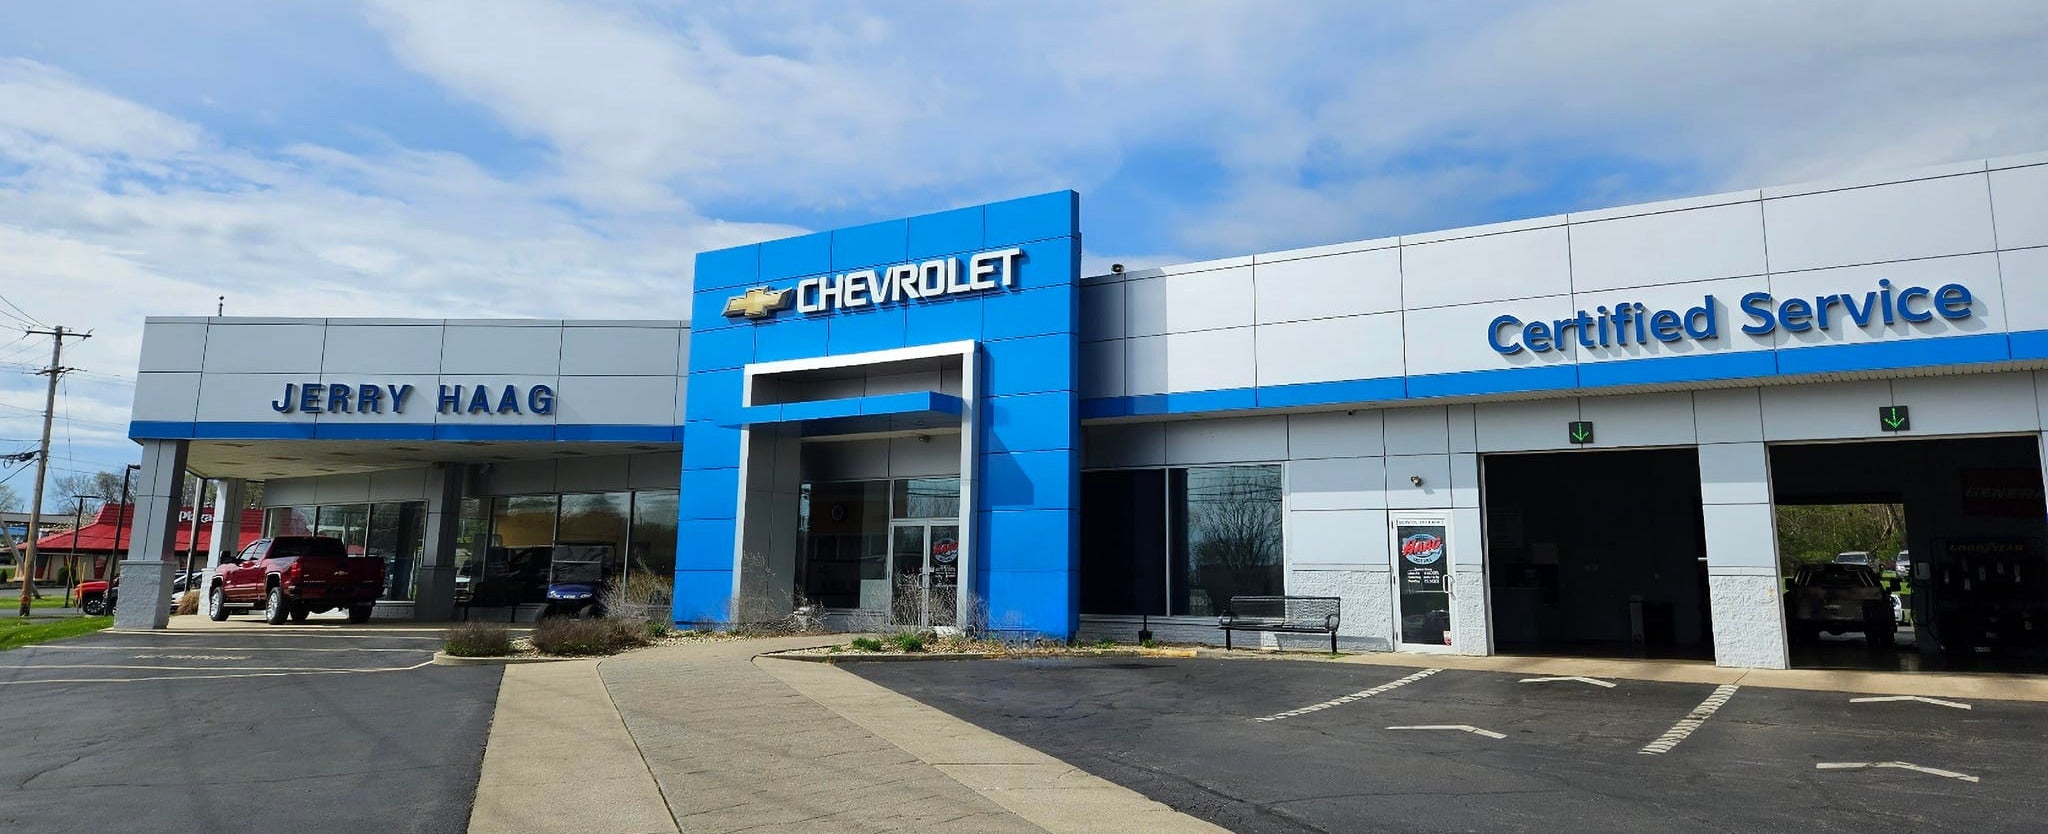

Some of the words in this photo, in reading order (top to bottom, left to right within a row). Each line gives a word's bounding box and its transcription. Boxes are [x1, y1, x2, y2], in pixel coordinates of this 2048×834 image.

[797, 247, 1022, 313] CHEVROLET
[1488, 294, 1719, 355] Certified
[1740, 278, 1973, 336] Service
[272, 383, 413, 414] JERRY
[437, 384, 556, 415] HAAG
